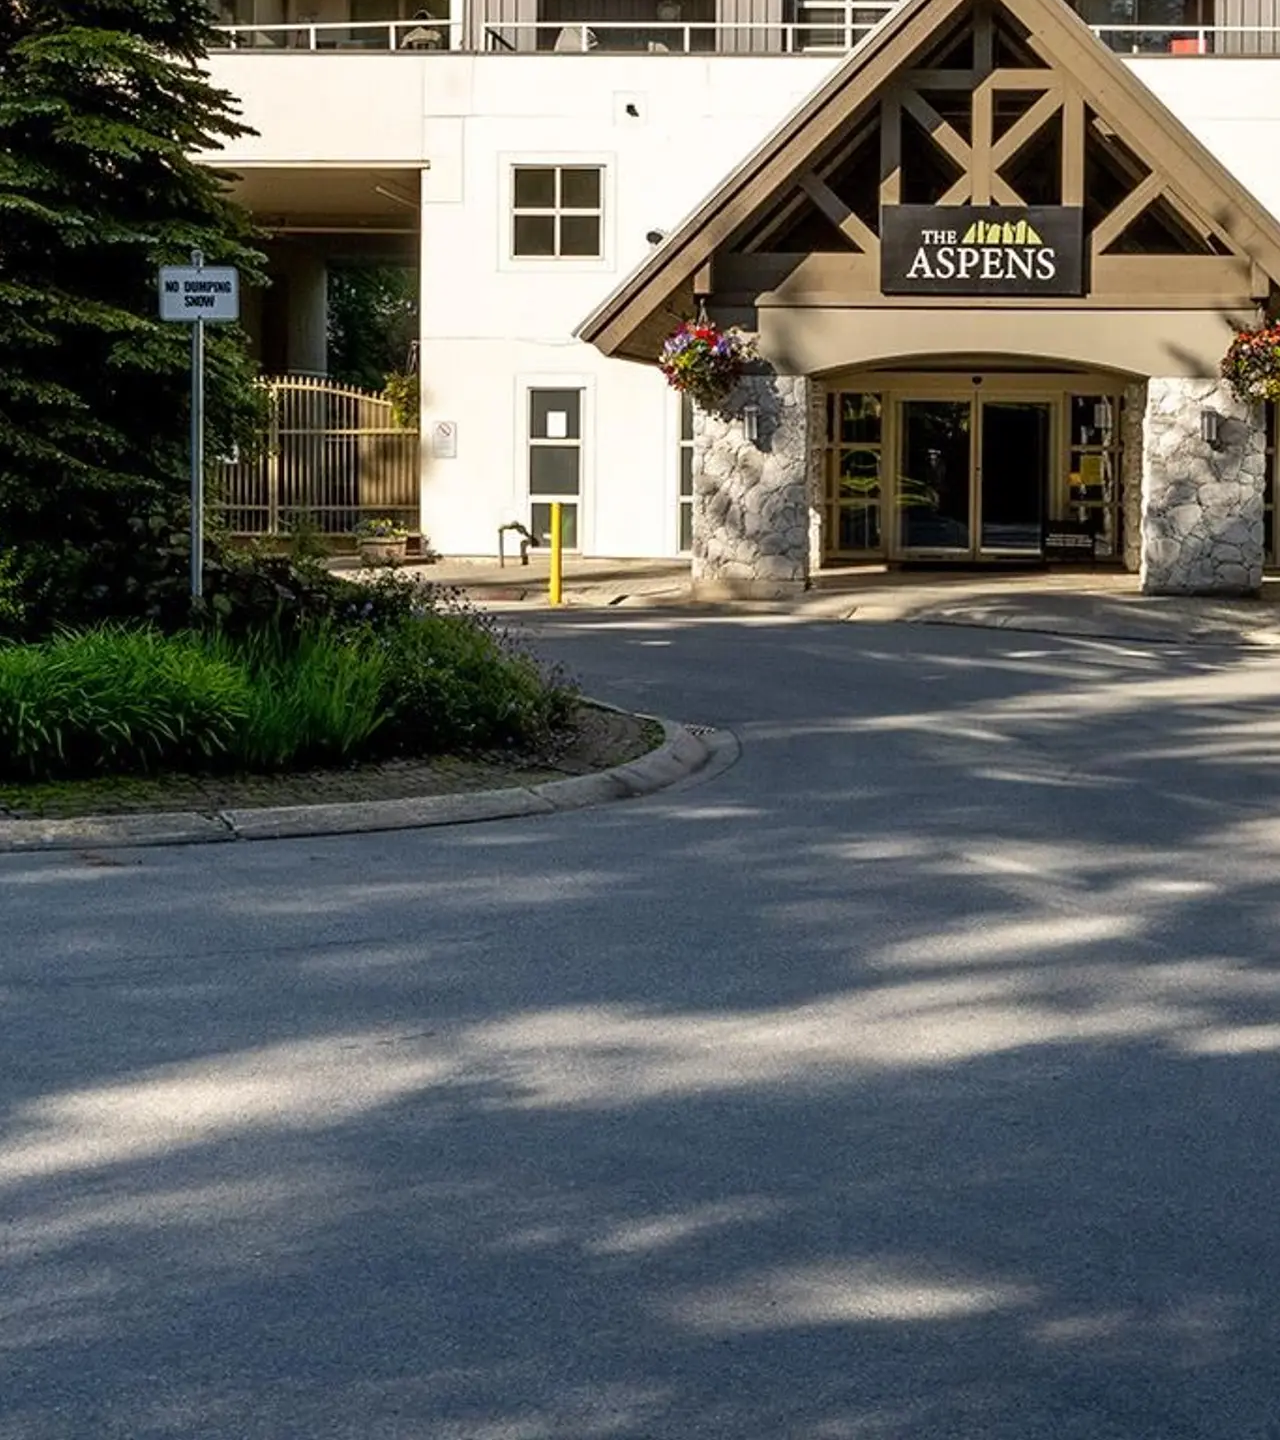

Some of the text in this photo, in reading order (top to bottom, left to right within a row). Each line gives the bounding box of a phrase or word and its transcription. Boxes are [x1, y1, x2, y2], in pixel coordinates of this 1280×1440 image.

[921, 230, 957, 244] THE
[906, 247, 1056, 280] ASPENS
[165, 281, 231, 293] NO DUMPING
[184, 295, 215, 307] SNOW
